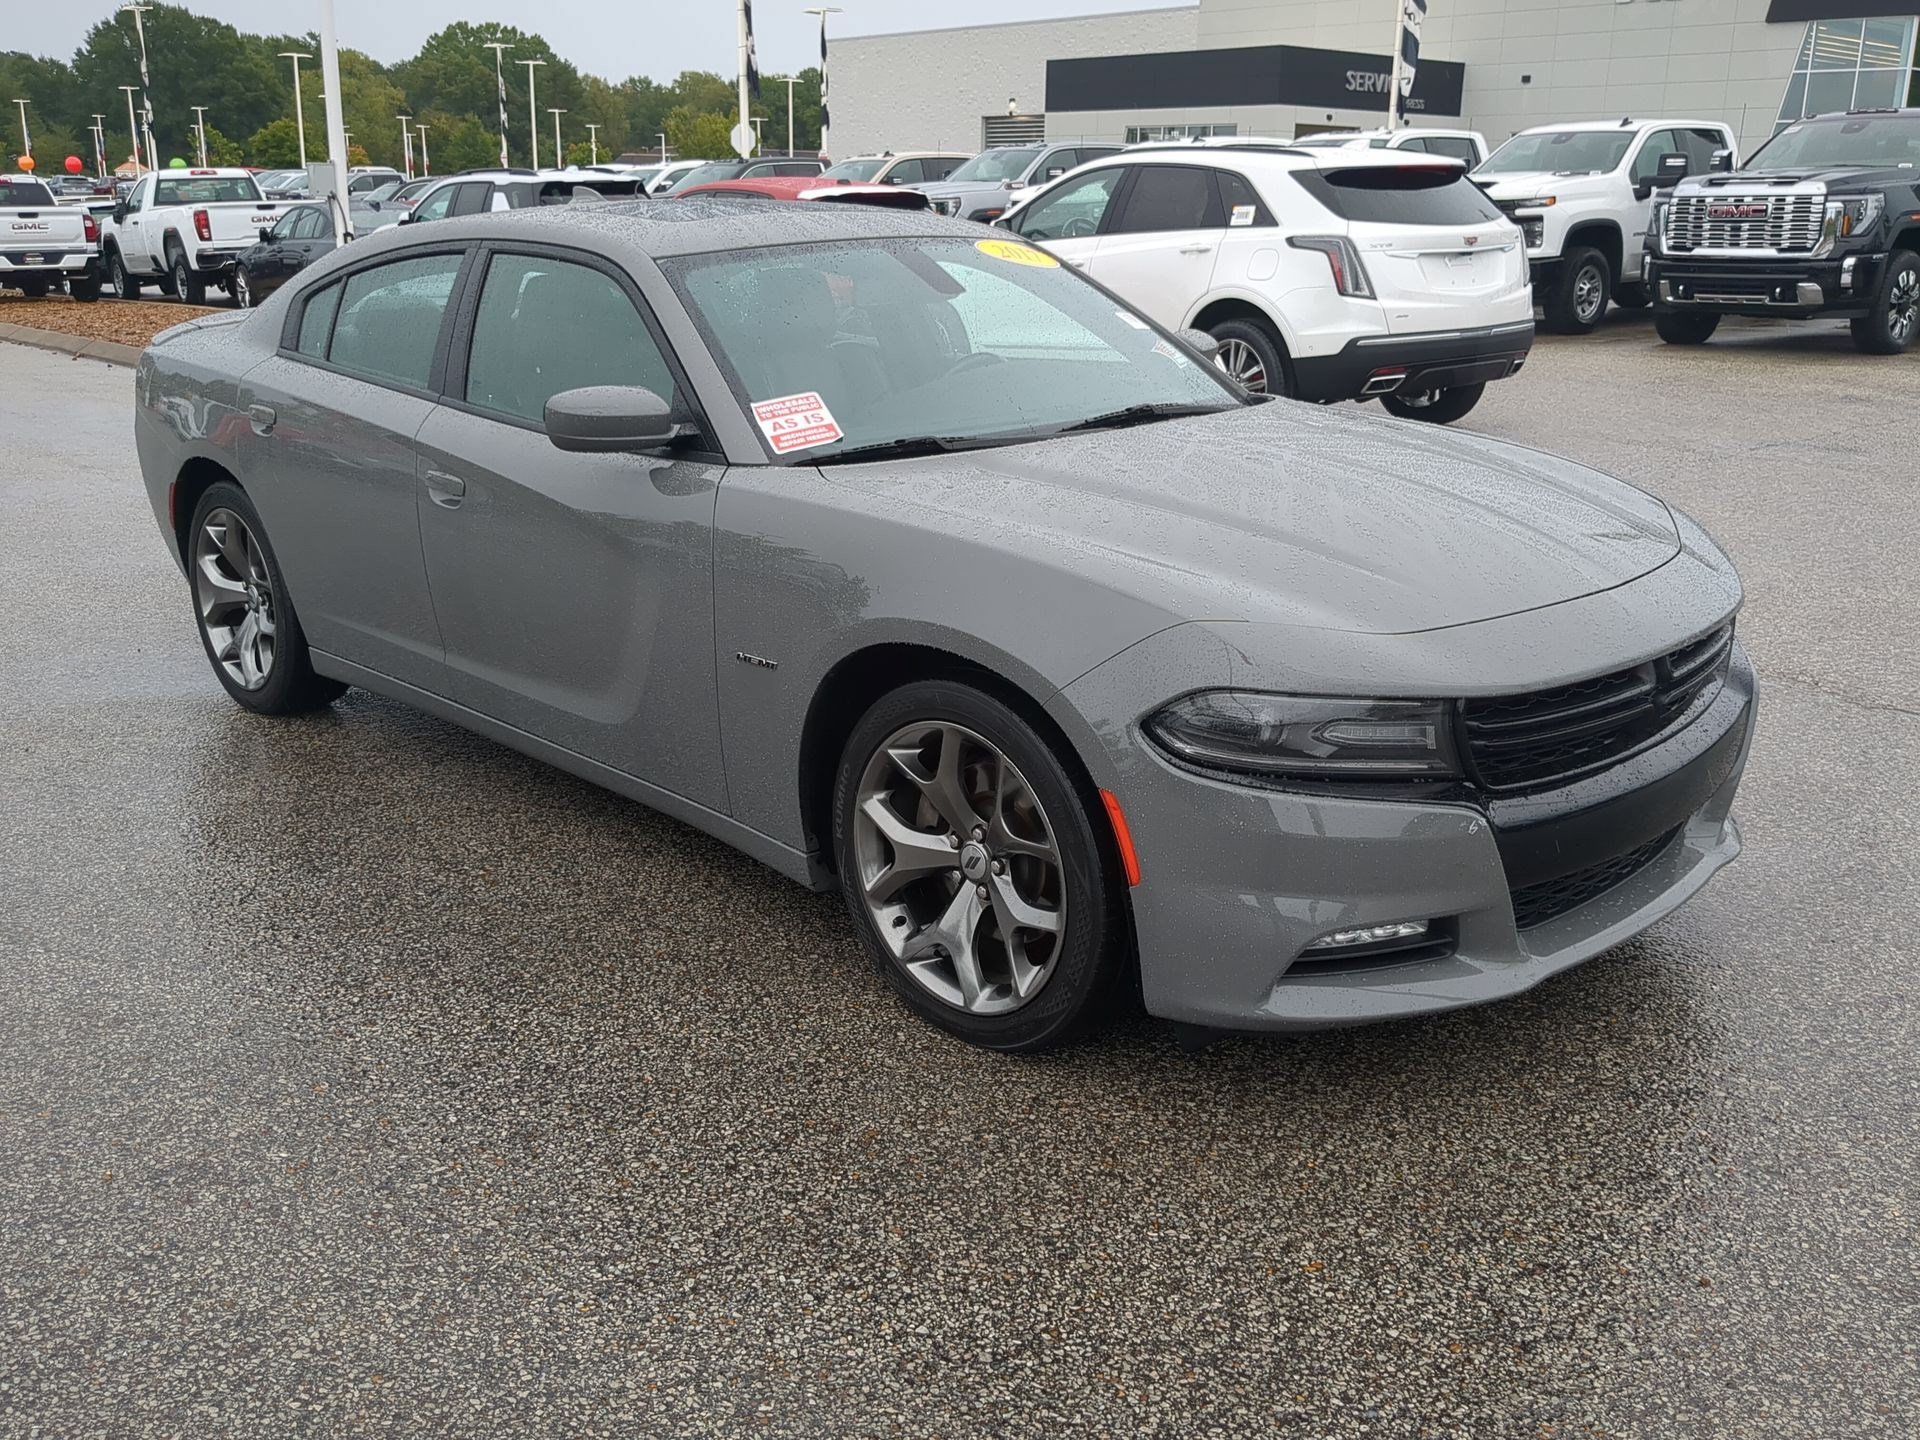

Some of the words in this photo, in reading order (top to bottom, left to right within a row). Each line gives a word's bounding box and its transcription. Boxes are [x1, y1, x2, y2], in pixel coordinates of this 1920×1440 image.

[1708, 204, 1767, 218] GMC
[11, 223, 50, 231] GMC
[756, 396, 817, 414] WHOLESALE
[760, 412, 773, 420] TO
[775, 408, 790, 417] THE
[790, 402, 821, 413] PUBLIC
[772, 418, 798, 432] AS
[803, 412, 825, 425] IS
